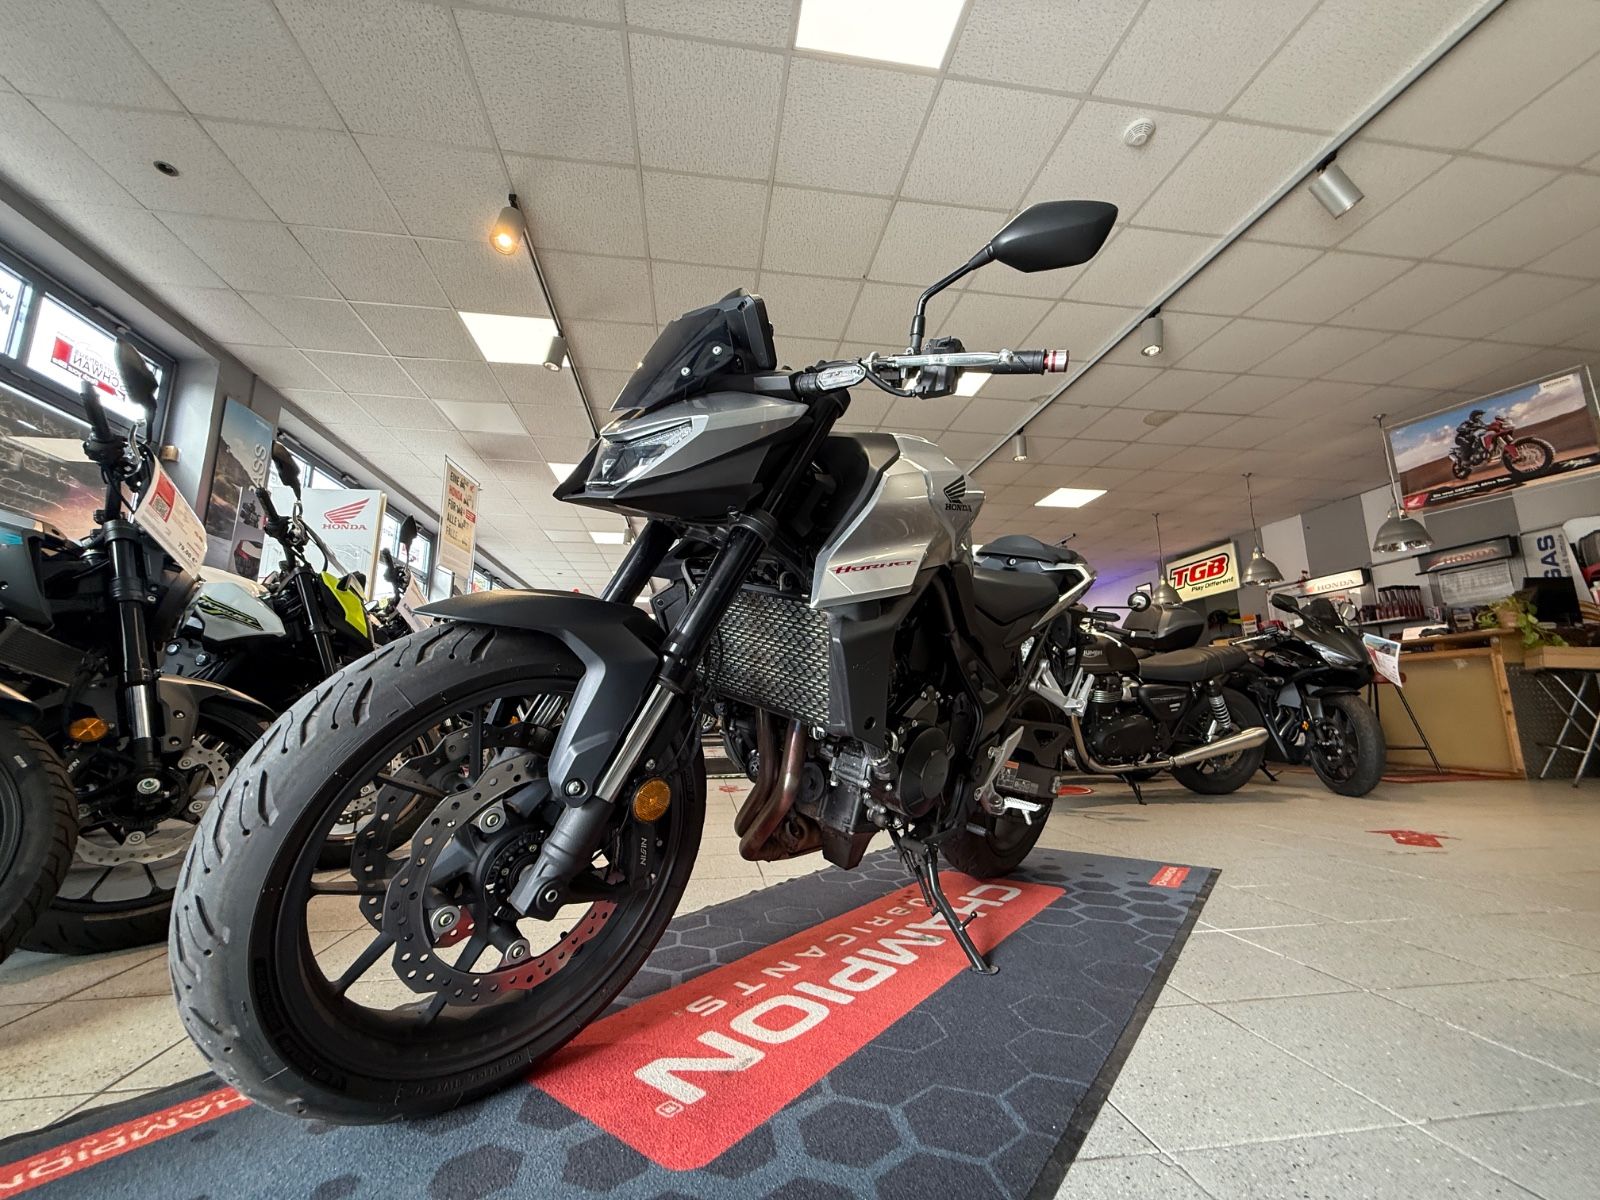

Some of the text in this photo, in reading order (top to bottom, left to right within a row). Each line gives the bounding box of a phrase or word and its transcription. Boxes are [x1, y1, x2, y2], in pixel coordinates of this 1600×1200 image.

[945, 503, 972, 512] HONDA
[1444, 547, 1498, 563] HONDA
[1172, 556, 1227, 587] TGB
[1191, 577, 1234, 592] Play Different
[1317, 579, 1354, 591] HONDA
[685, 897, 926, 1016] UBRICANTS
[634, 884, 1021, 1105] CHAMPION
[0, 1095, 247, 1188] HAMPION
[27, 1093, 226, 1169] UBRICANTS
